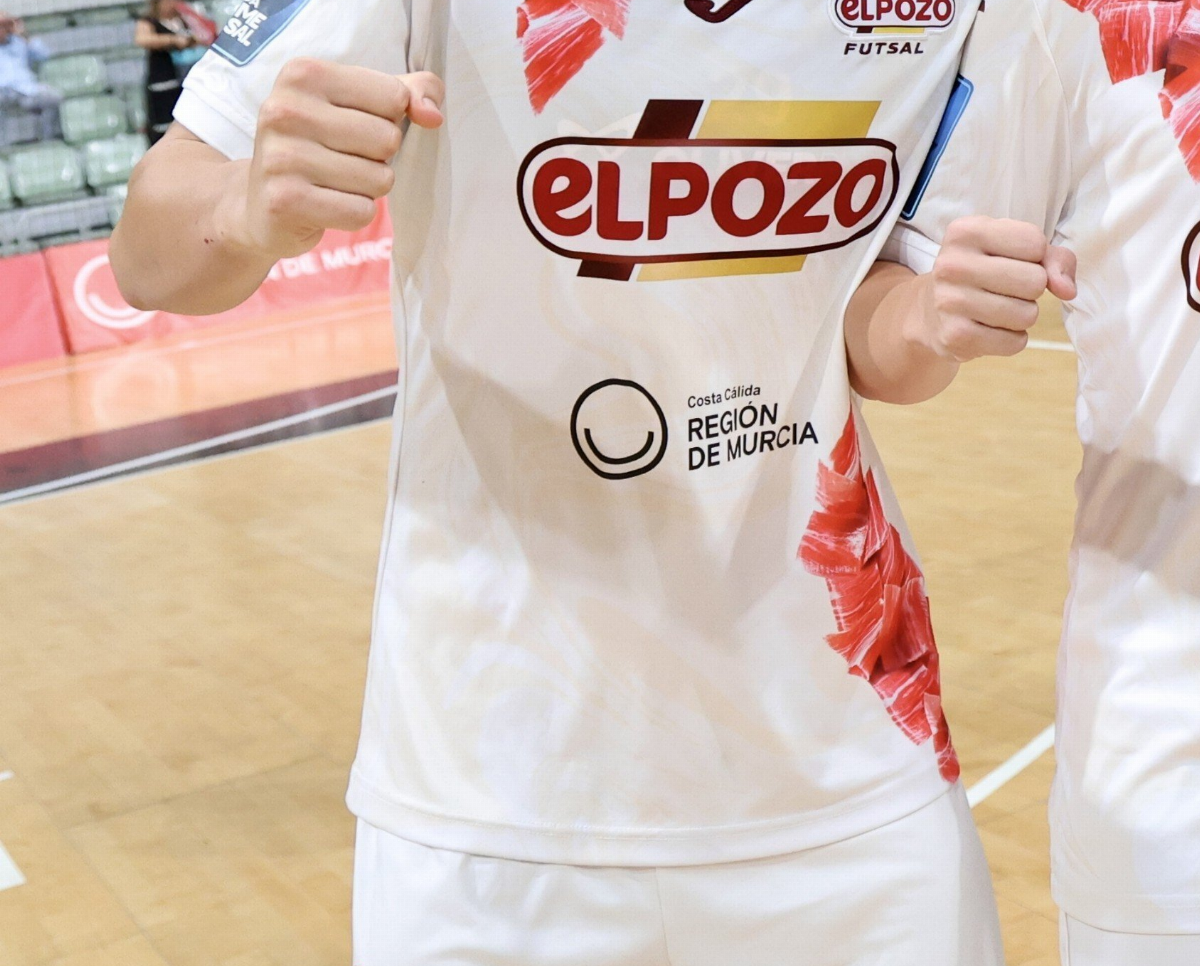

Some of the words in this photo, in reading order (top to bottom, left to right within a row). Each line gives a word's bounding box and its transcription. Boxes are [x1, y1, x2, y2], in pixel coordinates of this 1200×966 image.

[844, 42, 924, 55] FUTSAL
[282, 254, 317, 278] DE
[321, 237, 392, 270] MURC
[688, 392, 722, 408] Costa
[724, 384, 761, 400] Cálida
[688, 401, 778, 442] REGIÓN
[688, 443, 720, 471] DE
[727, 422, 819, 462] MURCIA
